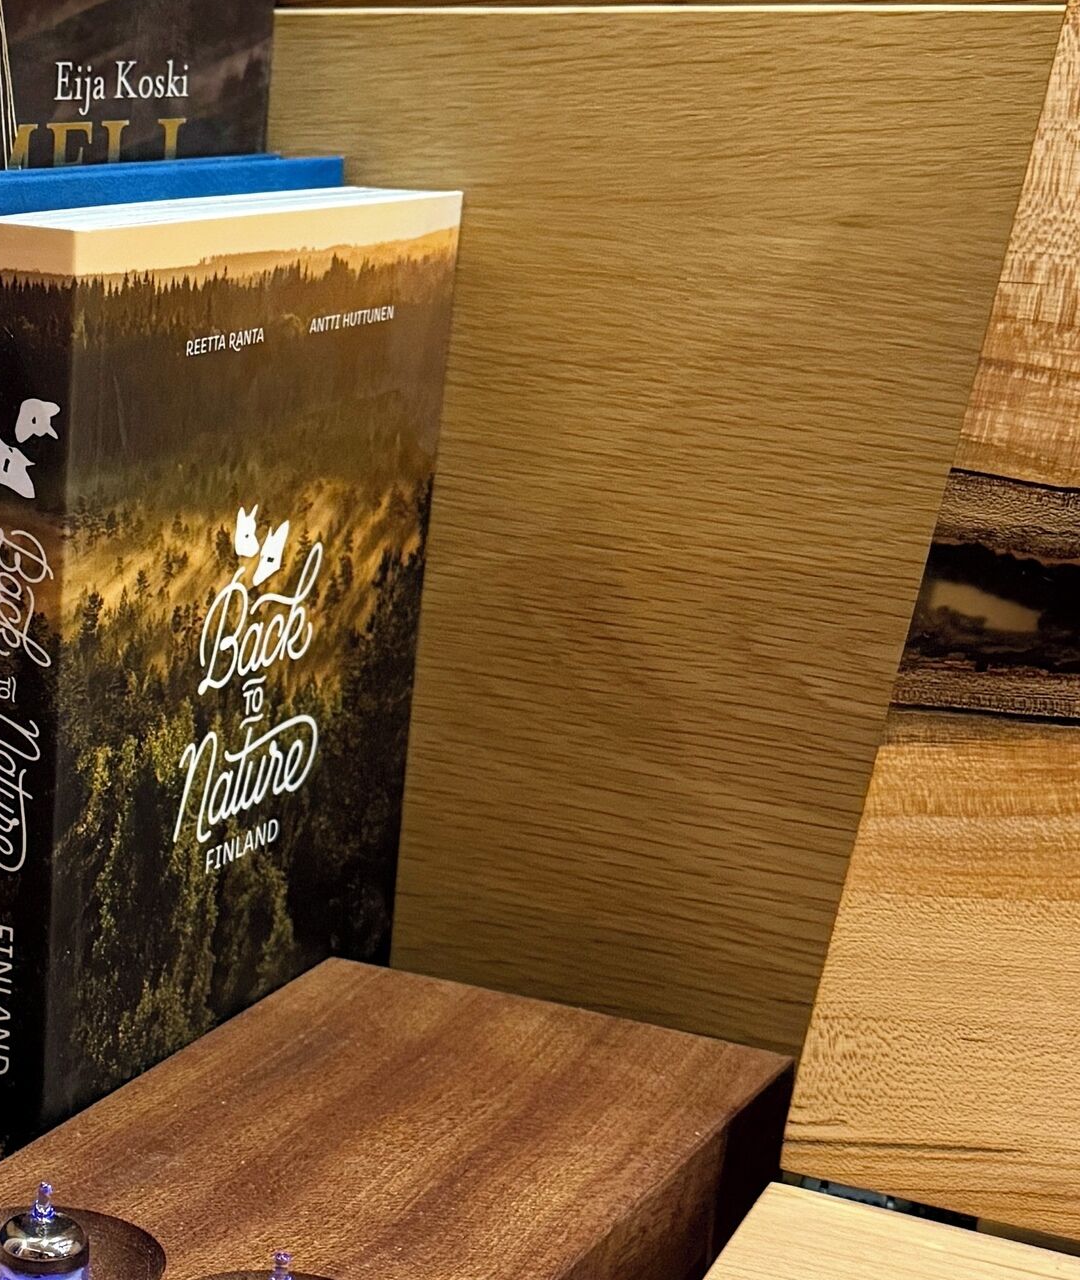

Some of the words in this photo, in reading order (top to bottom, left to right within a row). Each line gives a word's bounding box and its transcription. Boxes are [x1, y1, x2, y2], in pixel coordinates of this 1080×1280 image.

[54, 61, 106, 116] Eija
[114, 60, 189, 99] Koski
[185, 334, 226, 357] REETTA
[229, 327, 264, 352] RANTA
[309, 313, 340, 334] ANTTI
[342, 305, 395, 327] HUTTUNEN
[198, 541, 323, 696] Back
[172, 714, 319, 844] Nature
[204, 818, 280, 875] FINLAND
